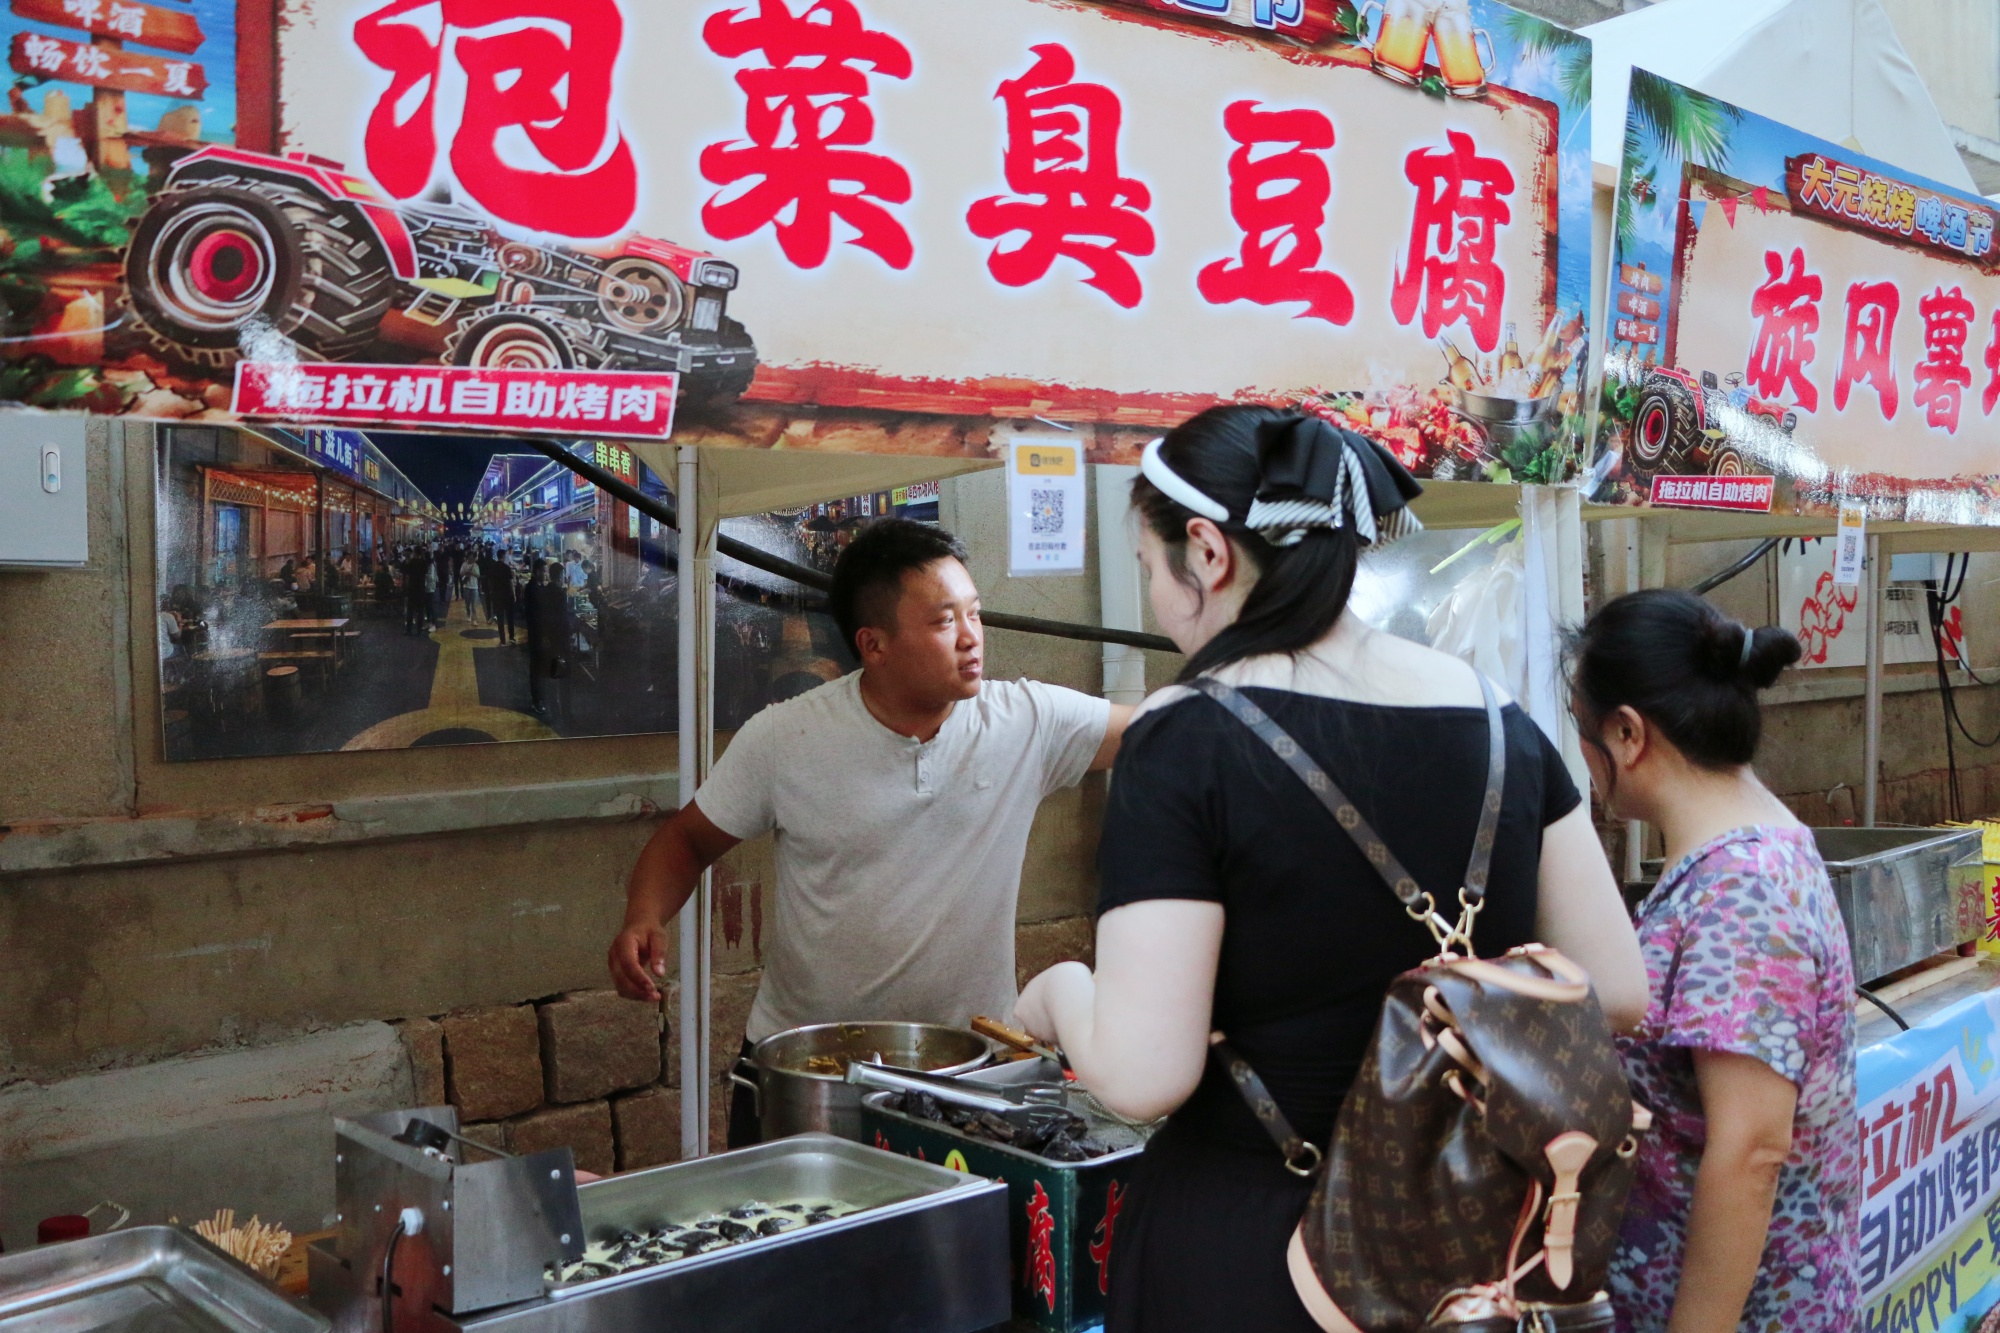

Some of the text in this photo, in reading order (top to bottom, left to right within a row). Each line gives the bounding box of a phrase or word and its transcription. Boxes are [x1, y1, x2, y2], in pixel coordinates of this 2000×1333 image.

[24, 35, 197, 95] 畅饮一夏
[353, 0, 1516, 353] 泡菜臭豆腐
[1800, 156, 1994, 256] 大元烧烤啤酒节
[1617, 319, 1657, 342] 畅饮一夏
[264, 373, 658, 422] 拖拉机自助烤肉
[596, 441, 631, 475] 串串香
[1658, 481, 1767, 502] 拖拉机自助烤肉
